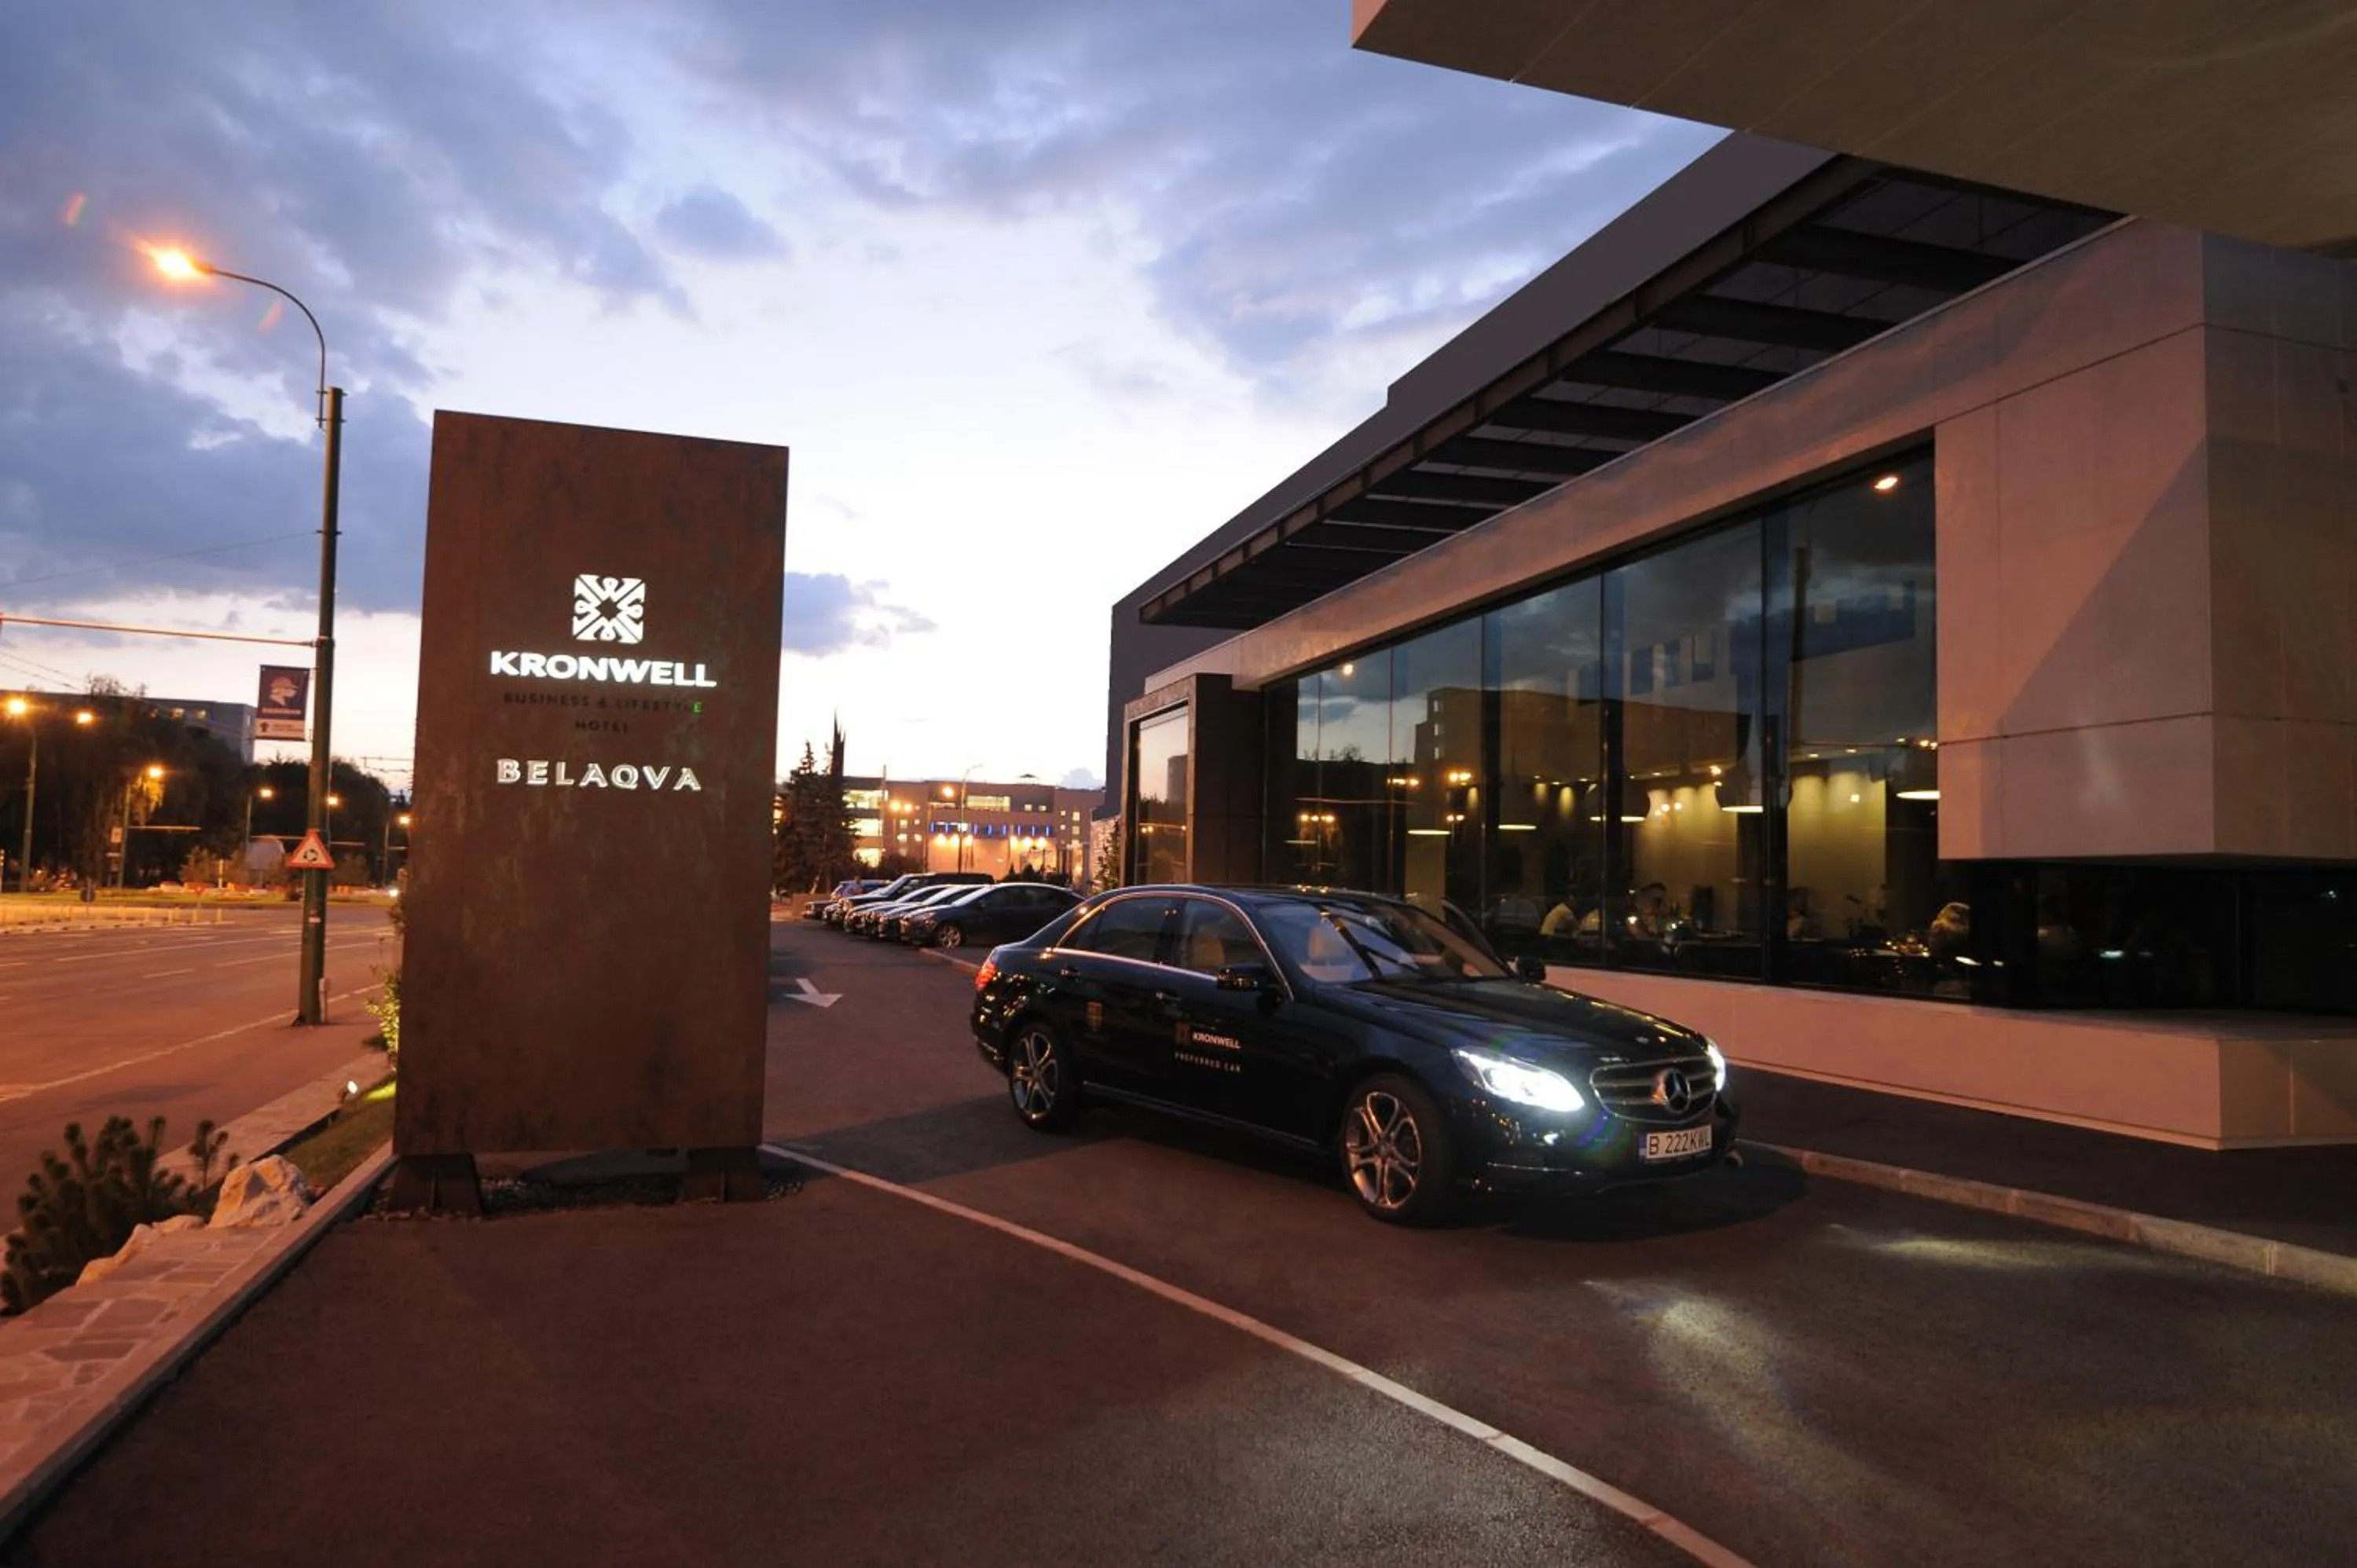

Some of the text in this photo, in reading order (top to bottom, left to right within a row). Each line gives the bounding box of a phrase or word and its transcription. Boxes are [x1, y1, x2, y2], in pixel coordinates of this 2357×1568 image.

[490, 650, 717, 687] KRONWELL
[504, 692, 589, 707] BUSINESS
[575, 719, 629, 734] HOTEL
[497, 759, 702, 790] BELAQVA
[1193, 1031, 1241, 1050] KRONWELL
[1175, 1052, 1241, 1072] PREFERRED CAR
[1649, 1135, 1659, 1156] B
